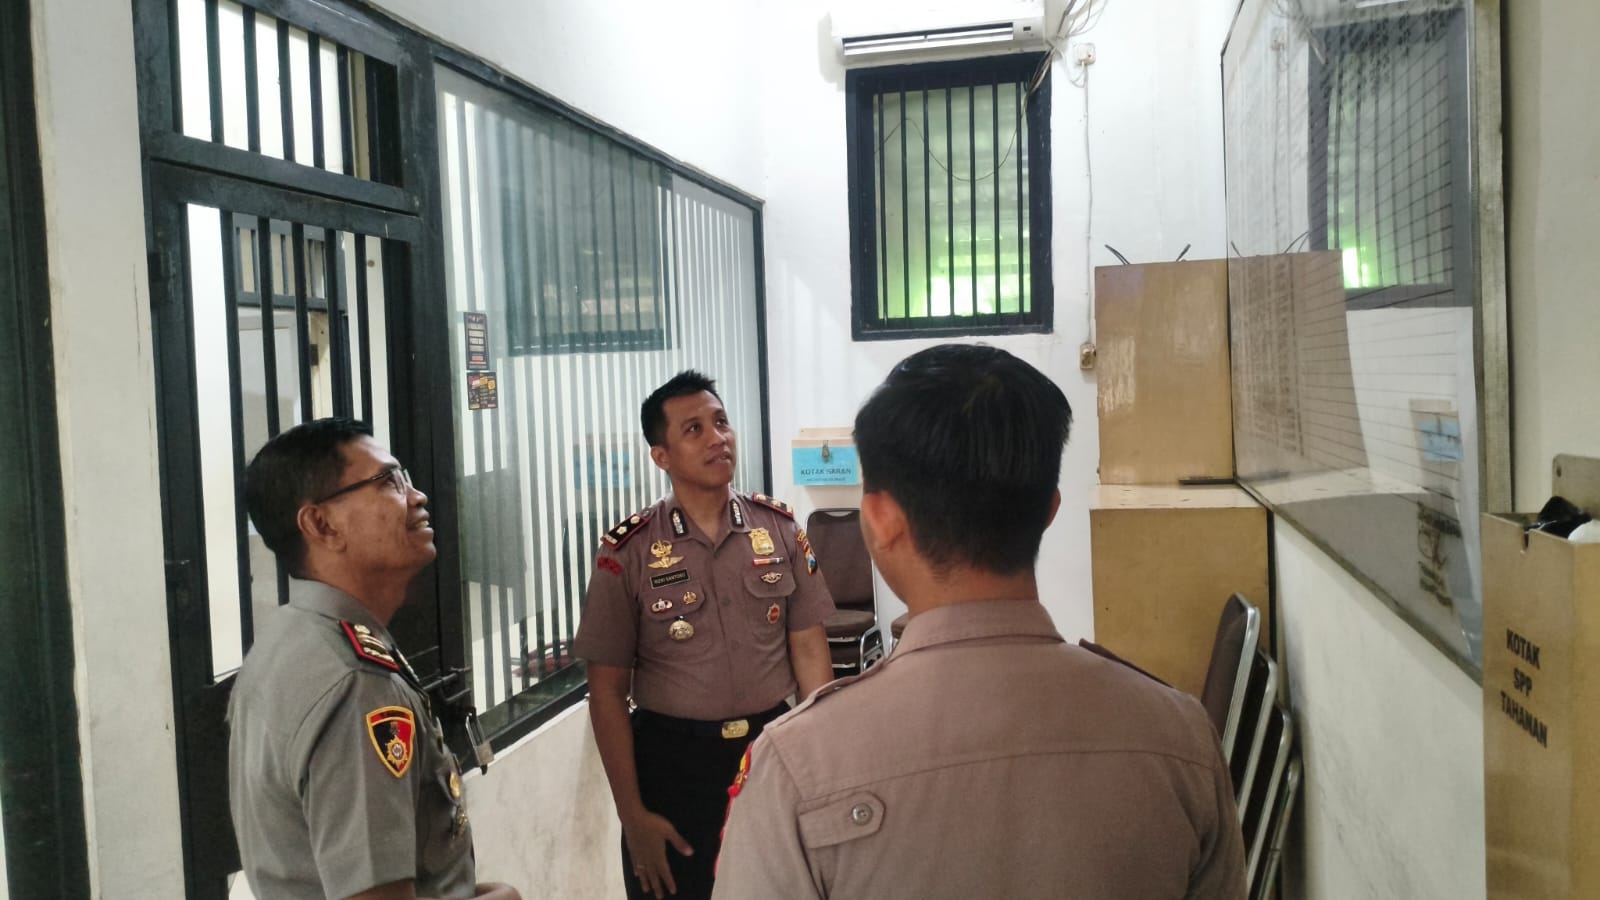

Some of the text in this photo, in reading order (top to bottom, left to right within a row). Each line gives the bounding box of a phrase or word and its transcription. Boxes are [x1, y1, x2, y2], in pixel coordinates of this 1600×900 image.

[801, 468, 824, 476] KOTAK
[1506, 627, 1540, 670] KOTAK
[1513, 666, 1532, 697] SPP
[1500, 689, 1547, 749] TAHANAN
